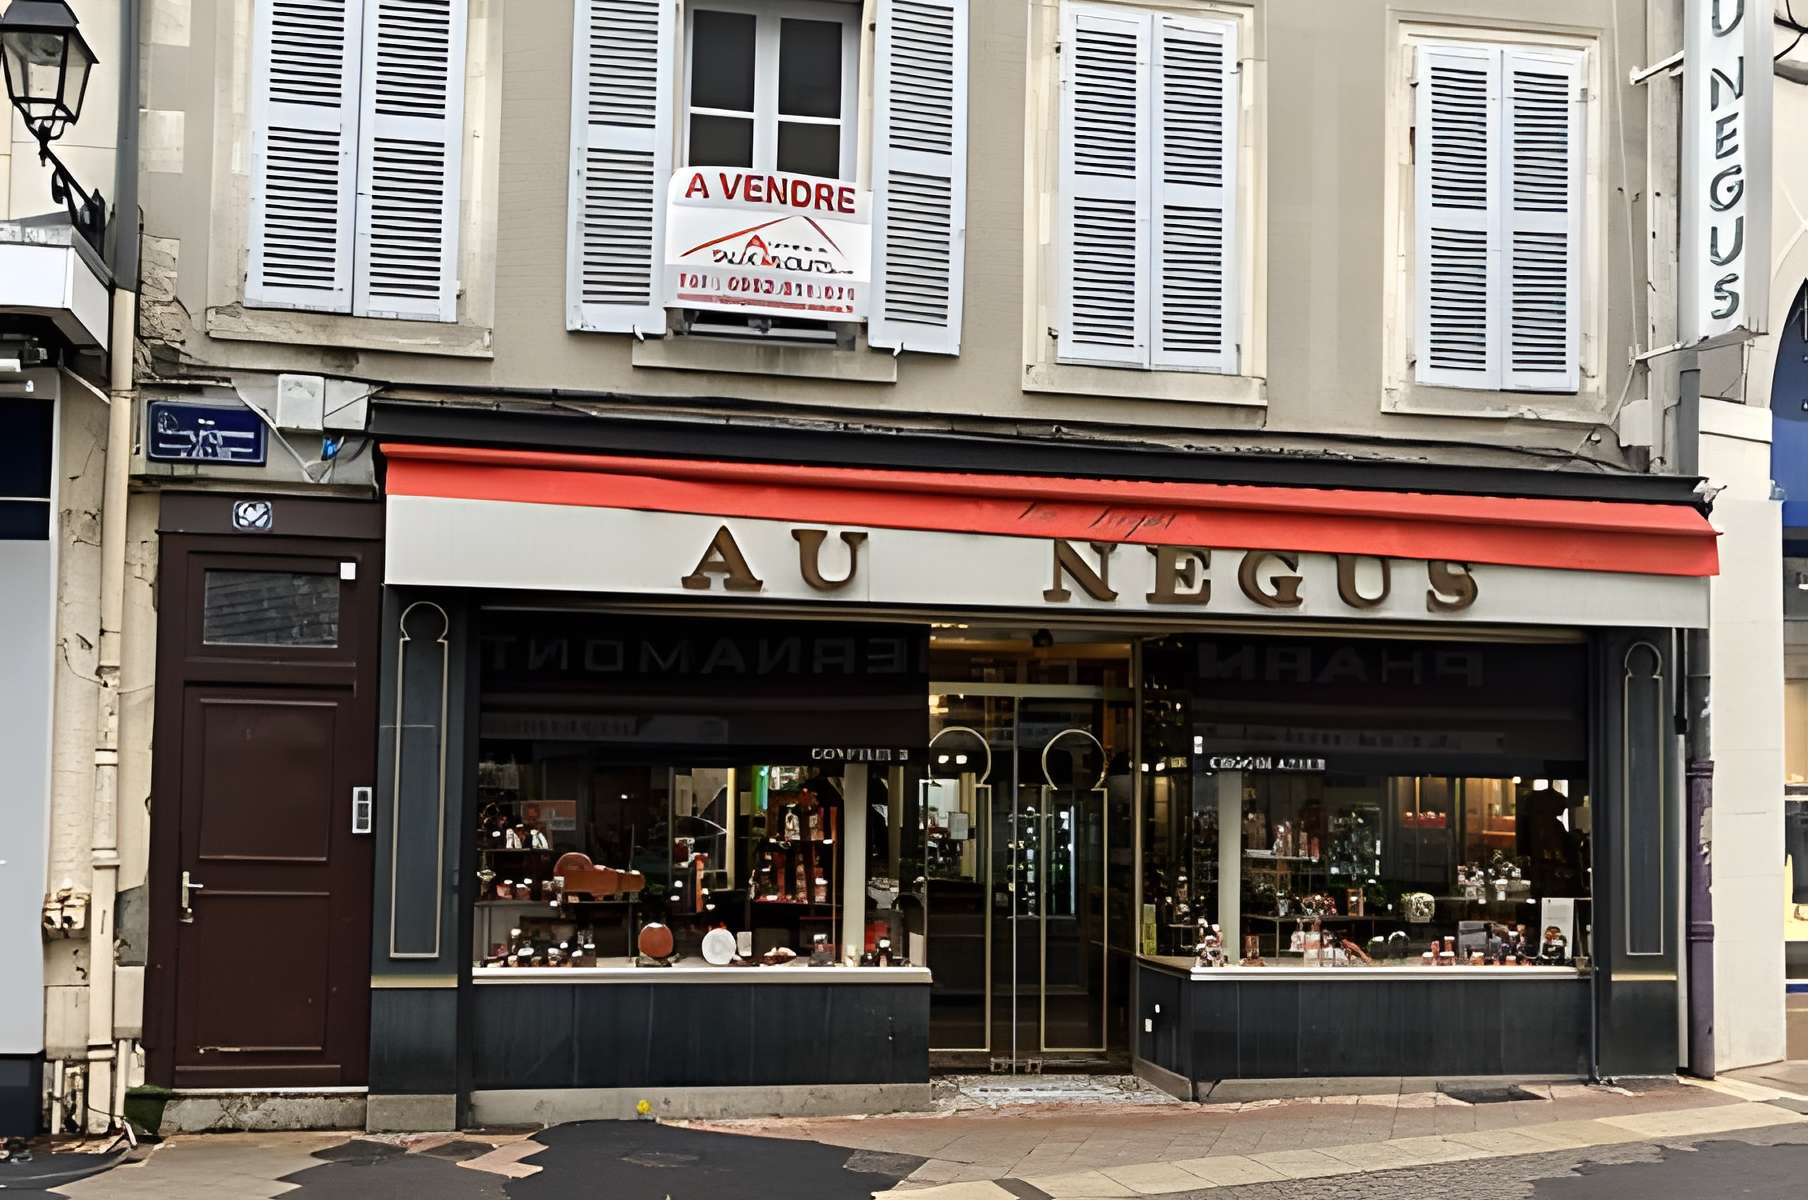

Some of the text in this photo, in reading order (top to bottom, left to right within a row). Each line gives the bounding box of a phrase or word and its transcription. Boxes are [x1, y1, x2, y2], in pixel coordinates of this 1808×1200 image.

[684, 172, 856, 214] A VENDRE
[1709, 55, 1745, 320] NEGUS
[681, 524, 1480, 614] AU NEGUS
